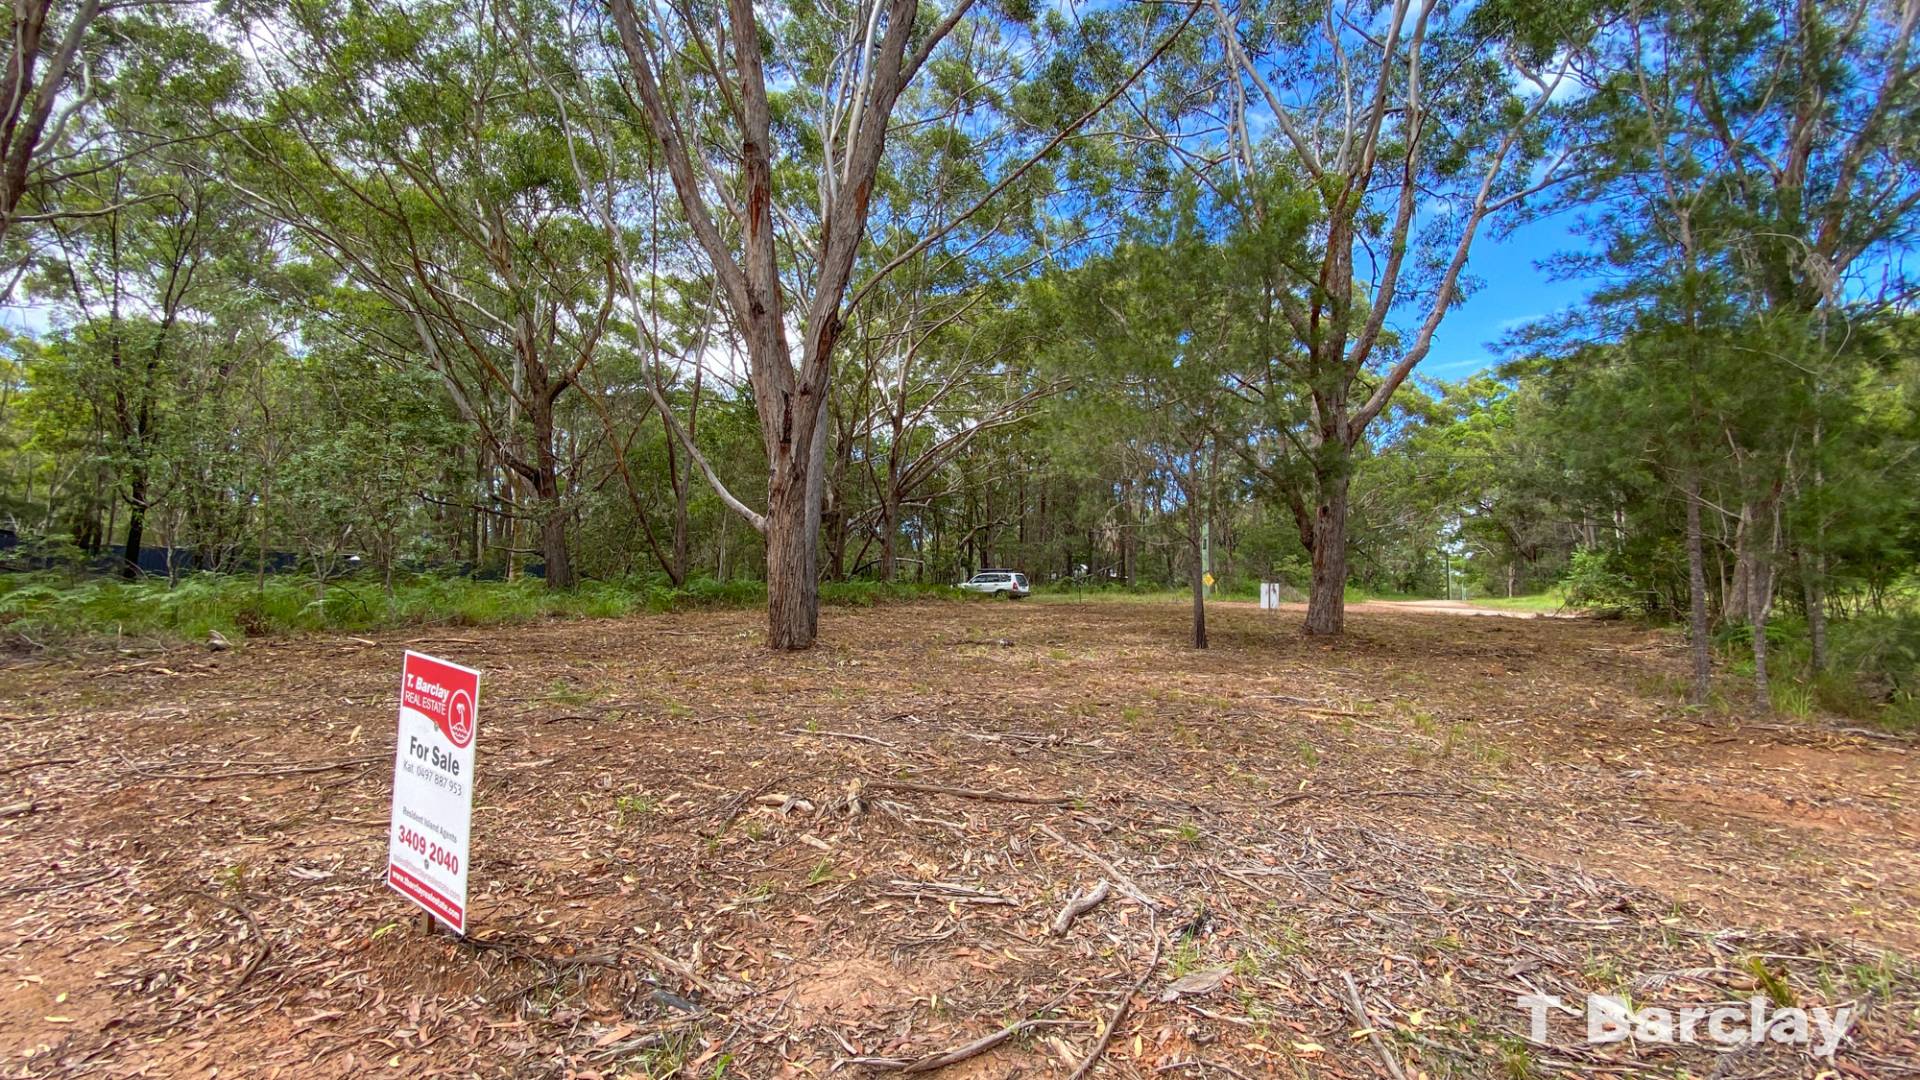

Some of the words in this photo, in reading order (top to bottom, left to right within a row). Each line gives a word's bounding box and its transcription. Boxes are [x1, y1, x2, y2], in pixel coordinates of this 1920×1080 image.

[405, 690, 422, 706] REAL
[422, 696, 447, 715] ESTATE
[407, 673, 414, 688] T.
[415, 676, 450, 702] Barclay
[410, 735, 429, 761] For
[432, 745, 460, 776] Sale
[416, 766, 433, 782] 0497
[434, 774, 448, 788] 887
[449, 780, 462, 796] 953
[398, 824, 426, 855] 3409
[429, 842, 459, 875] 2040
